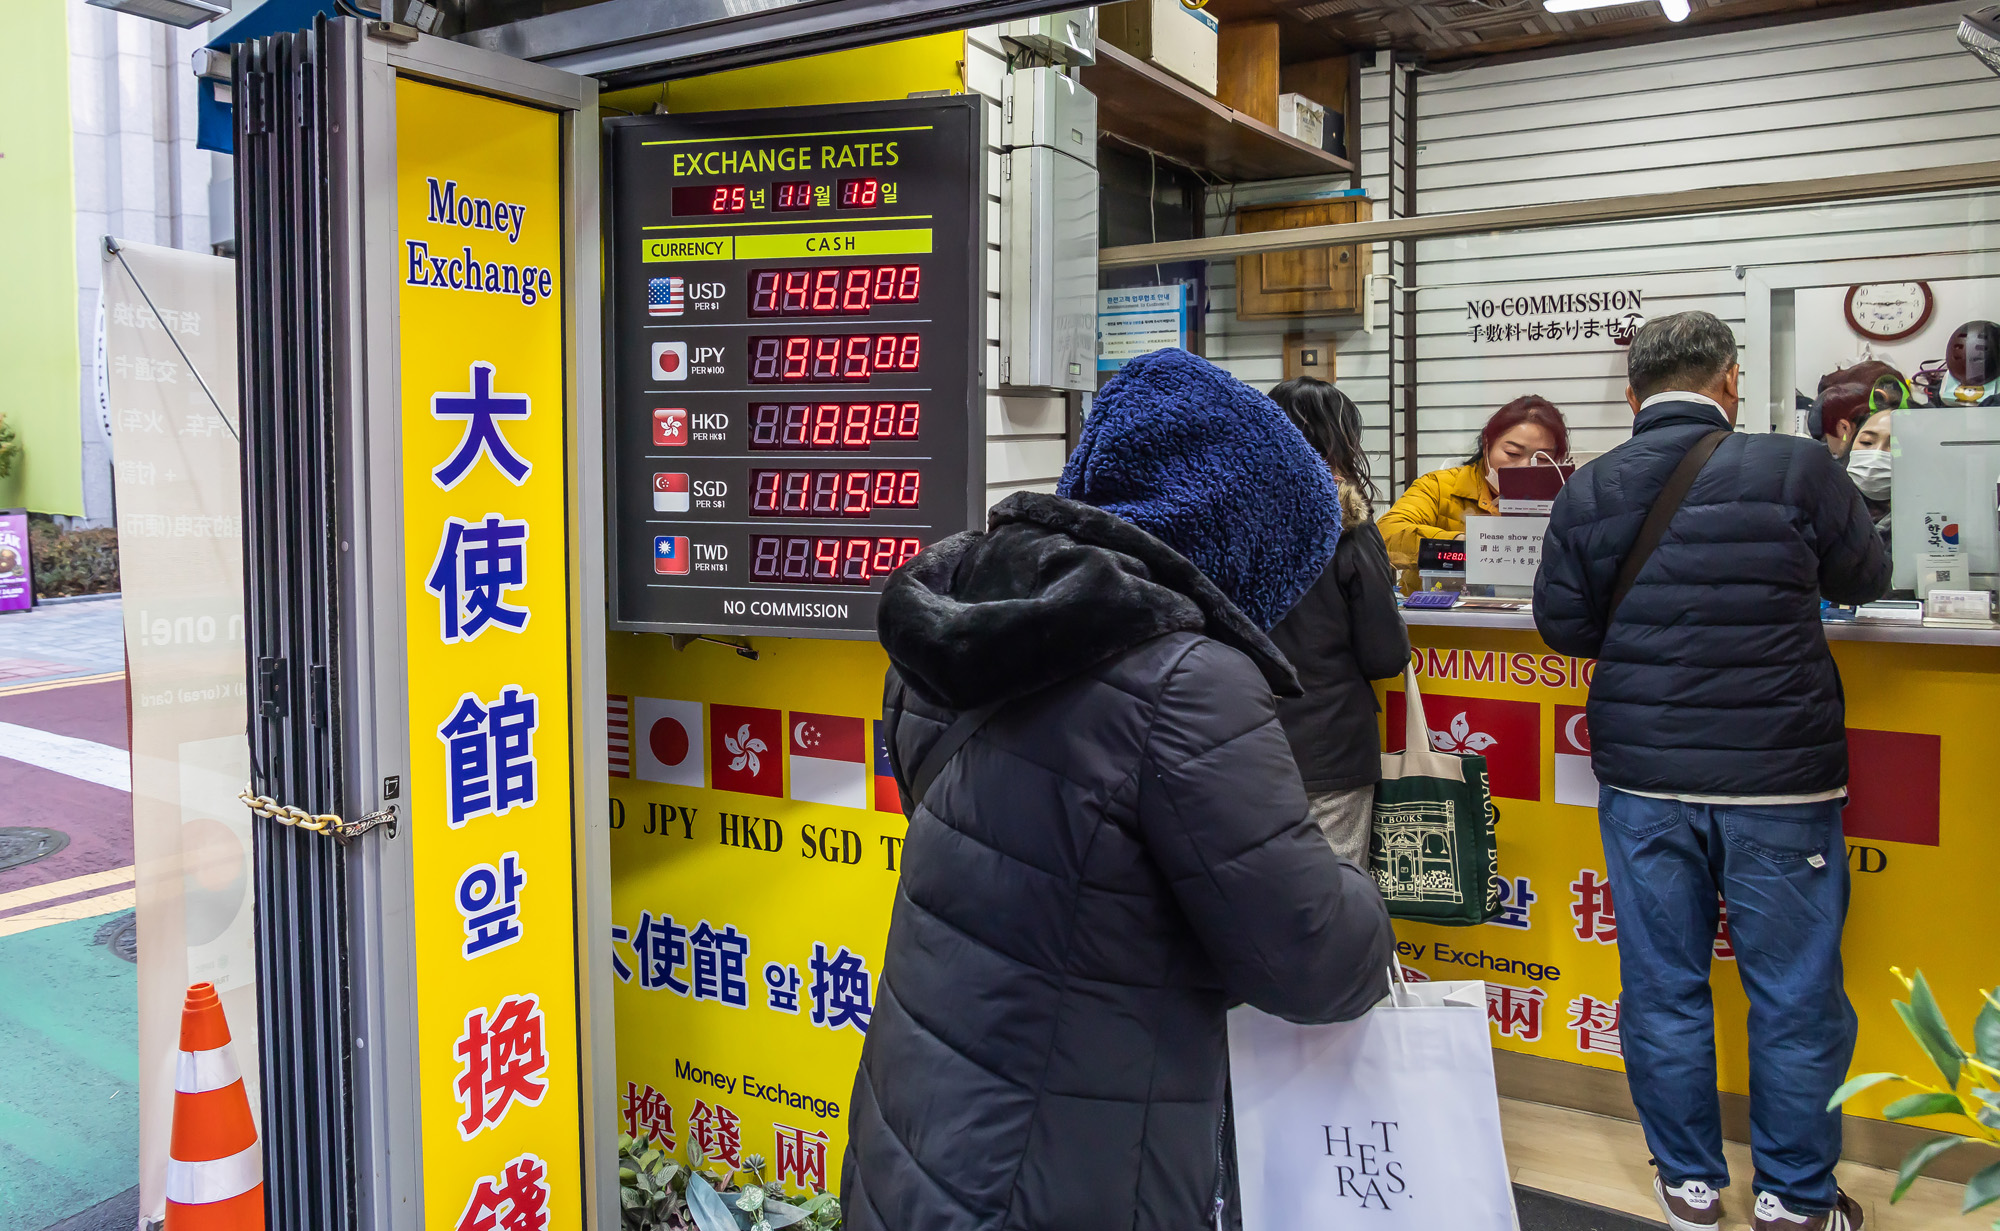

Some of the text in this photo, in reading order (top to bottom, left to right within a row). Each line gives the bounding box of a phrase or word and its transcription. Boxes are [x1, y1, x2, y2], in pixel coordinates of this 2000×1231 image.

[673, 142, 899, 176] EXCHANGE RATES
[427, 177, 525, 244] Money
[651, 241, 724, 257] CURRENCY
[805, 236, 856, 252] CASH
[406, 241, 552, 306] Exchange
[689, 282, 726, 299] USD
[711, 302, 719, 310] $1
[1467, 289, 1643, 319] NO COMMISSION
[690, 347, 725, 364] JPY
[691, 366, 706, 375] PER
[691, 413, 729, 430] HKD
[693, 480, 728, 498] SGD
[696, 500, 726, 508] PER S$1
[1479, 532, 1504, 541] Please
[1508, 533, 1528, 541] show
[693, 544, 728, 561] TWD
[695, 563, 728, 571] PER NT$1
[724, 600, 848, 619] NO COMMISSION
[1389, 813, 1423, 824] BOOKS
[643, 802, 698, 840] JPY
[719, 812, 783, 853] HKD
[801, 824, 862, 866] SGD
[1480, 771, 1499, 913] DAUNT BOOKS
[1434, 942, 1561, 981] Exchange
[675, 1058, 840, 1119] Money Exchange
